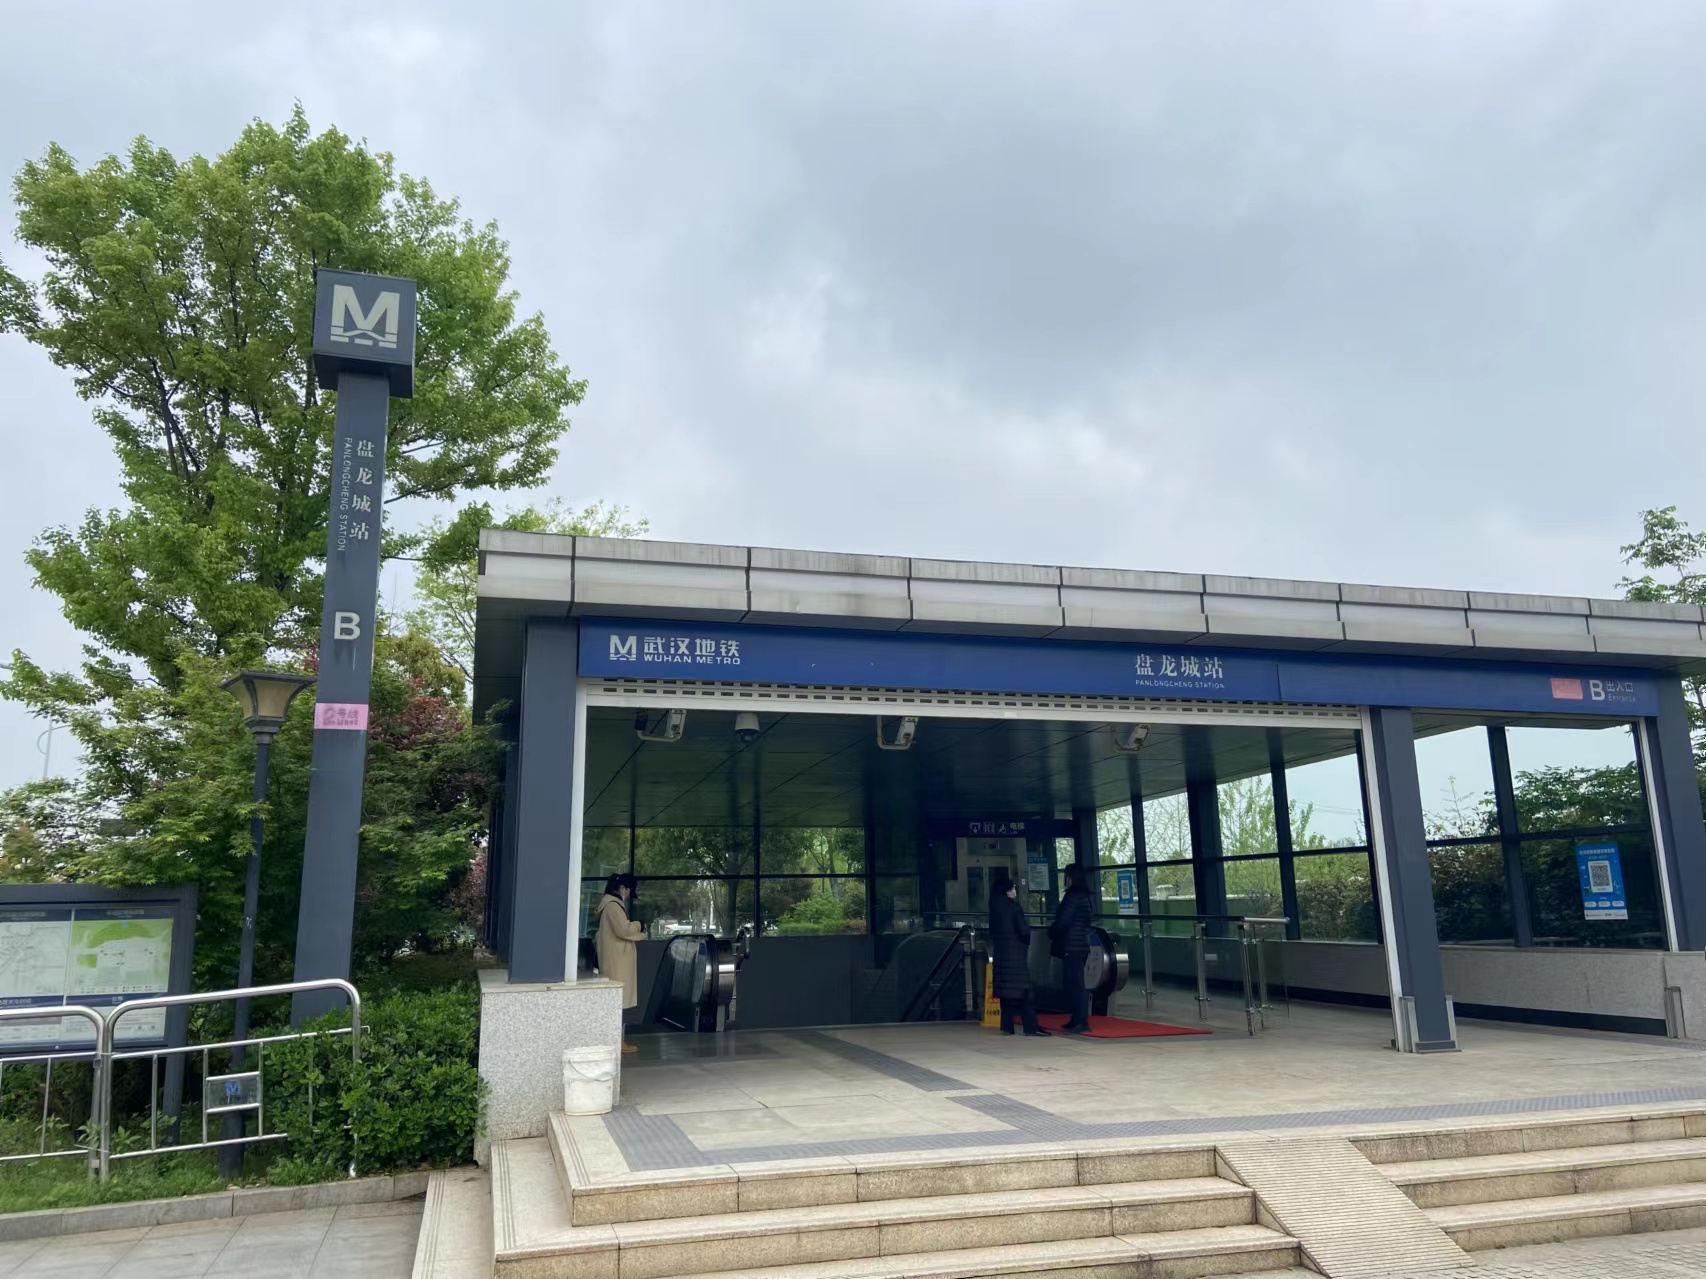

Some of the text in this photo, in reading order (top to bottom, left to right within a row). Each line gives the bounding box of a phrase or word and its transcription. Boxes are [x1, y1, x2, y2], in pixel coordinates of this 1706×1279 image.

[337, 437, 353, 551] PANLONGCHENG STATION
[349, 440, 375, 540] 盘龙城站
[334, 611, 361, 640] B
[644, 636, 740, 657] 武汉地铁
[644, 654, 741, 665] WUHAN METRO
[1134, 654, 1223, 679] 盘龙城站
[1135, 680, 1193, 688] PANLONGCHENG
[1589, 680, 1606, 700] B
[1606, 680, 1634, 692] 出入口
